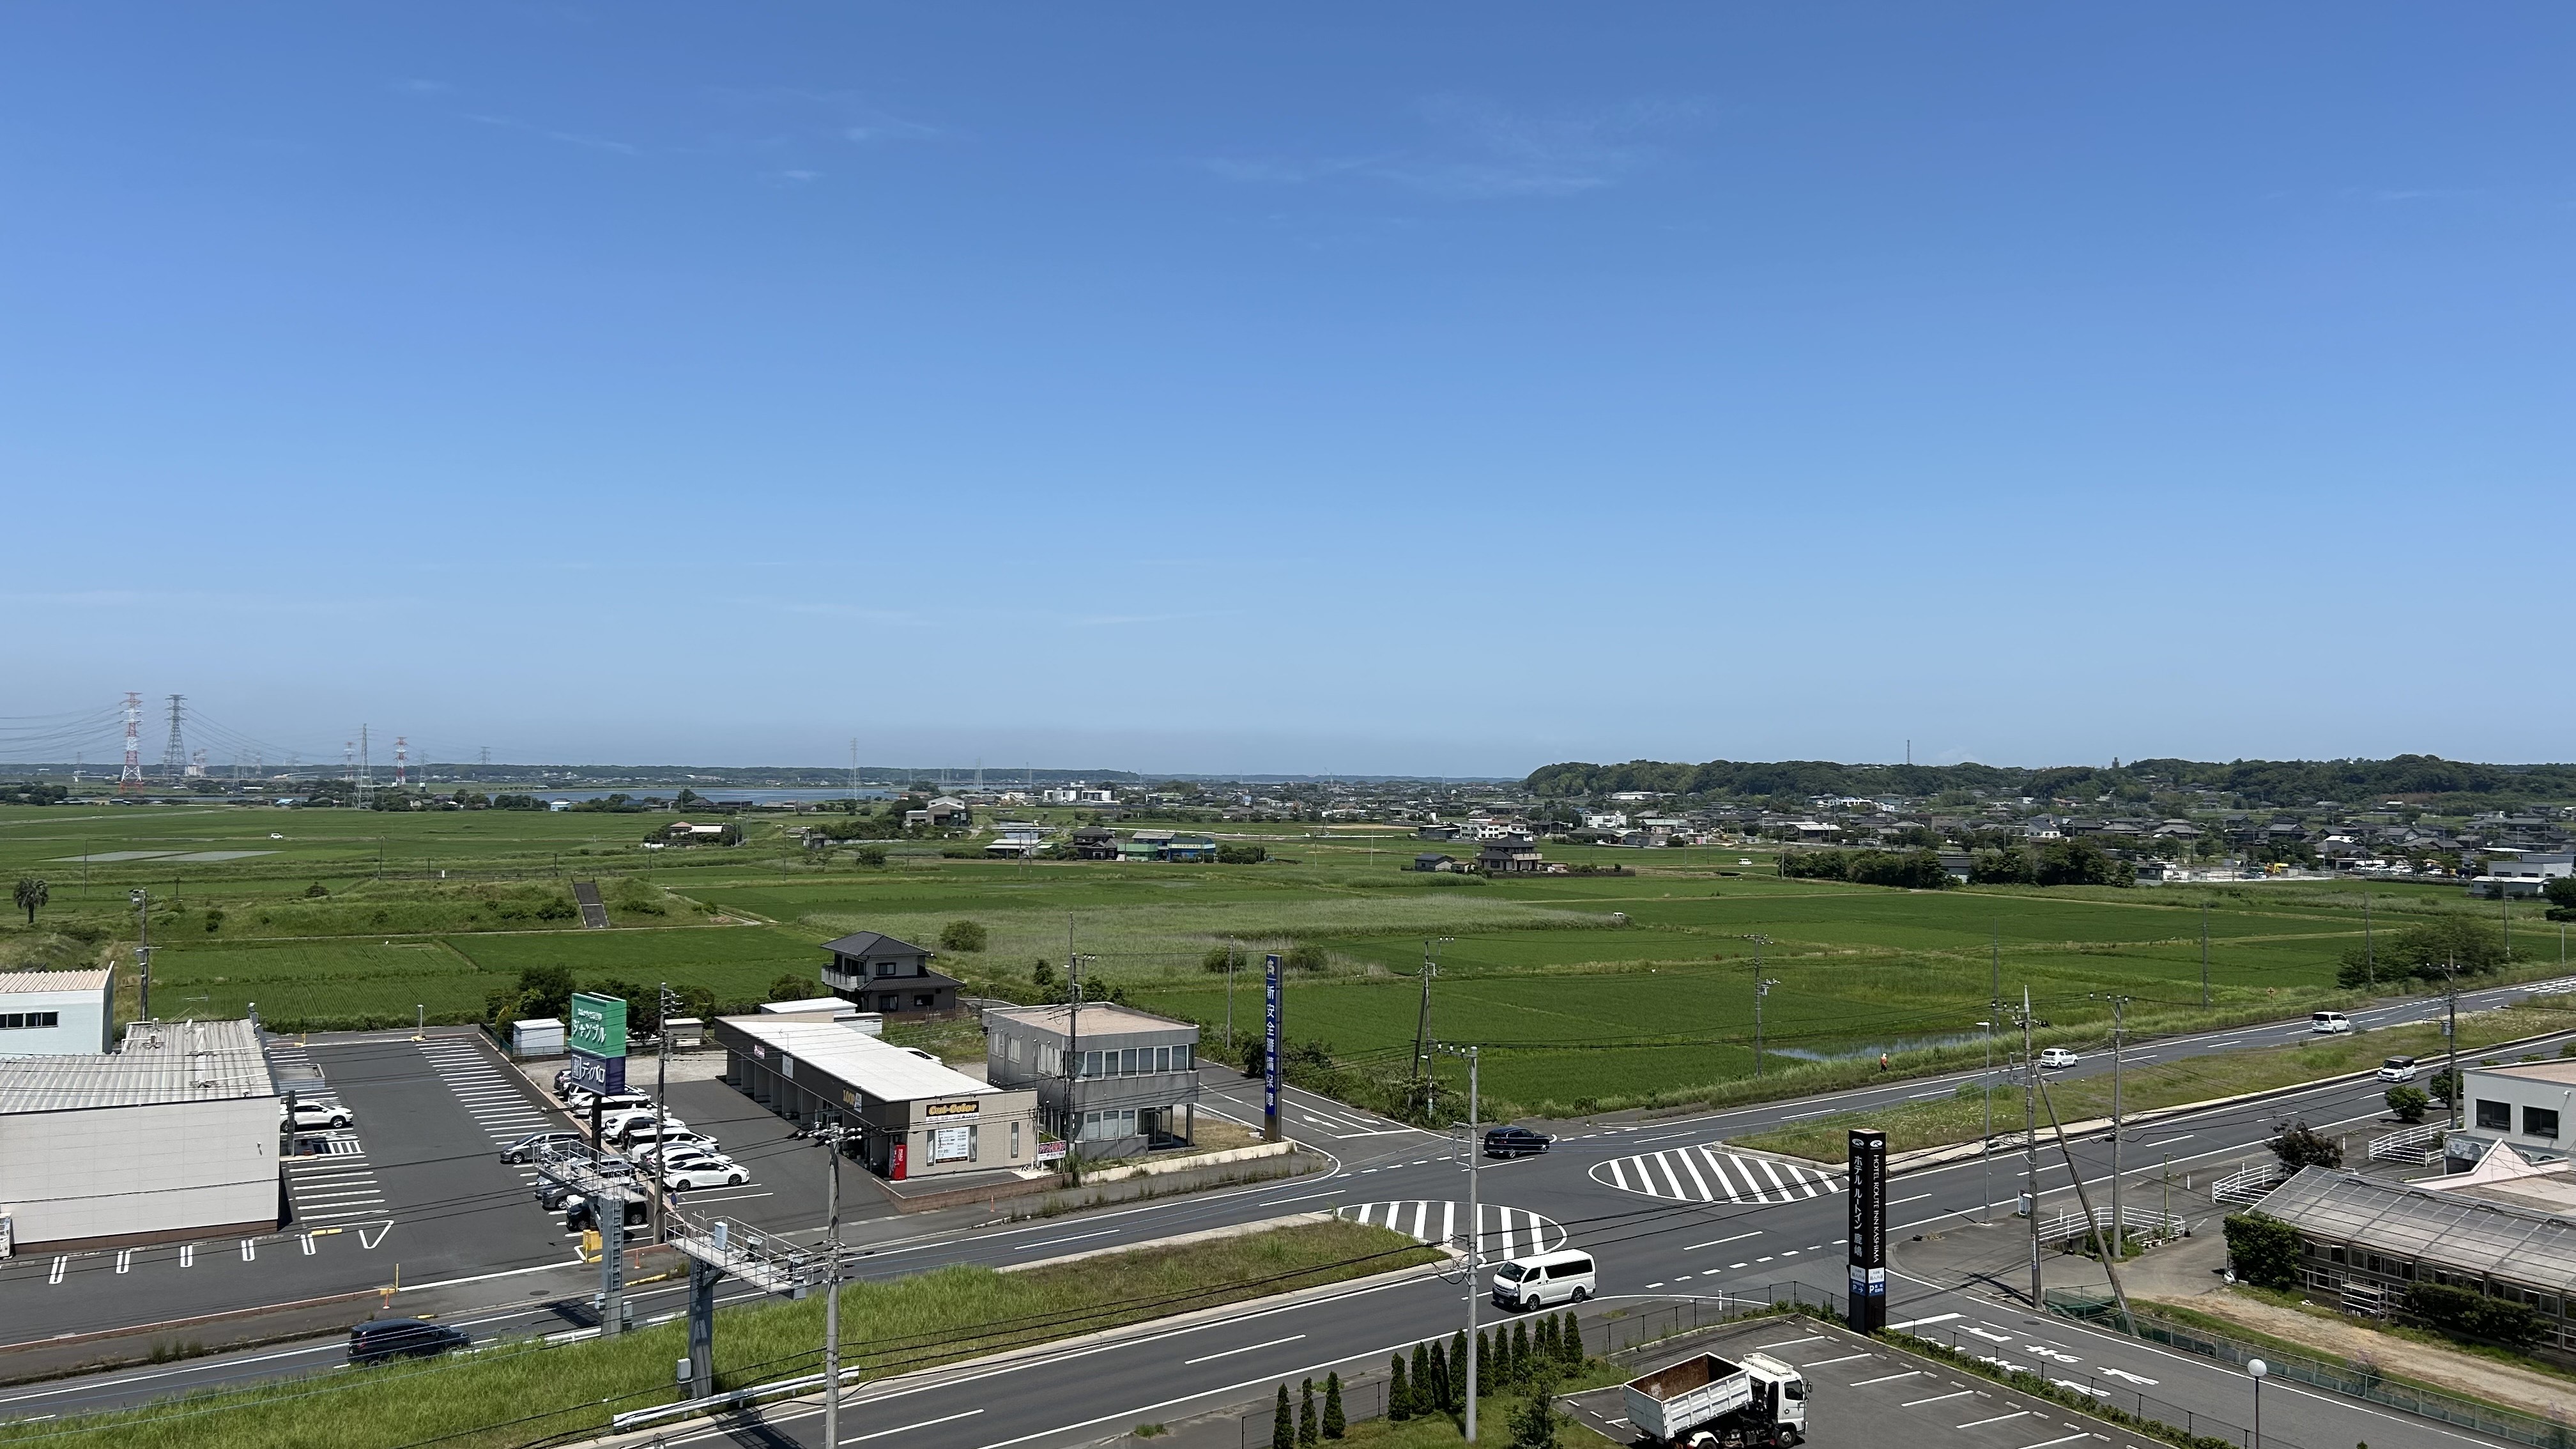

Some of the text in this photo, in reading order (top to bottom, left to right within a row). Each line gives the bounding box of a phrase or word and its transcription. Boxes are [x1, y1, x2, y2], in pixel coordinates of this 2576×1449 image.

[1266, 985, 1275, 1107] 新安全警備保障
[1854, 1155, 1863, 1257] ホテル ルートイン 鹿嶋
[1869, 1285, 1874, 1294] P
